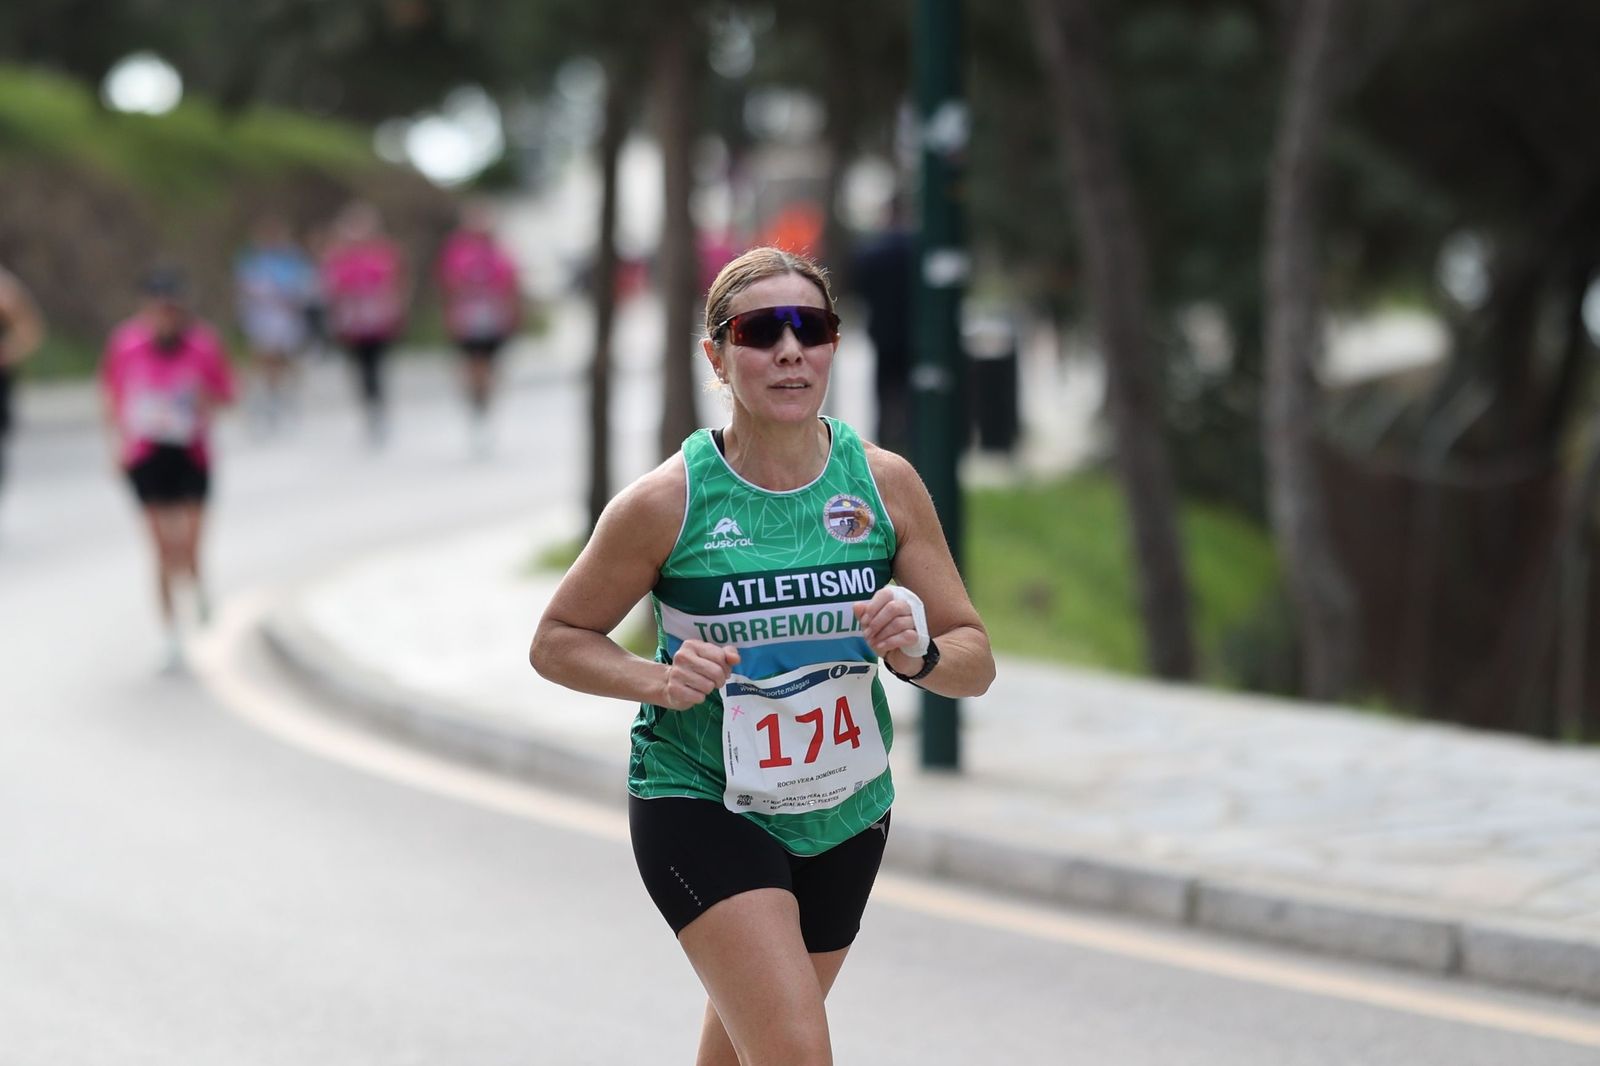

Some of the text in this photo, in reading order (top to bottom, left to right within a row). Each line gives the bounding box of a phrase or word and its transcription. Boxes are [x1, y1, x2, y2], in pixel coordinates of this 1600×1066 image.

[704, 537, 754, 550] austral
[718, 566, 876, 609] ATLETISMO
[694, 610, 862, 644] TORREMOLI
[756, 696, 861, 769] 174
[797, 776, 814, 784] VERA
